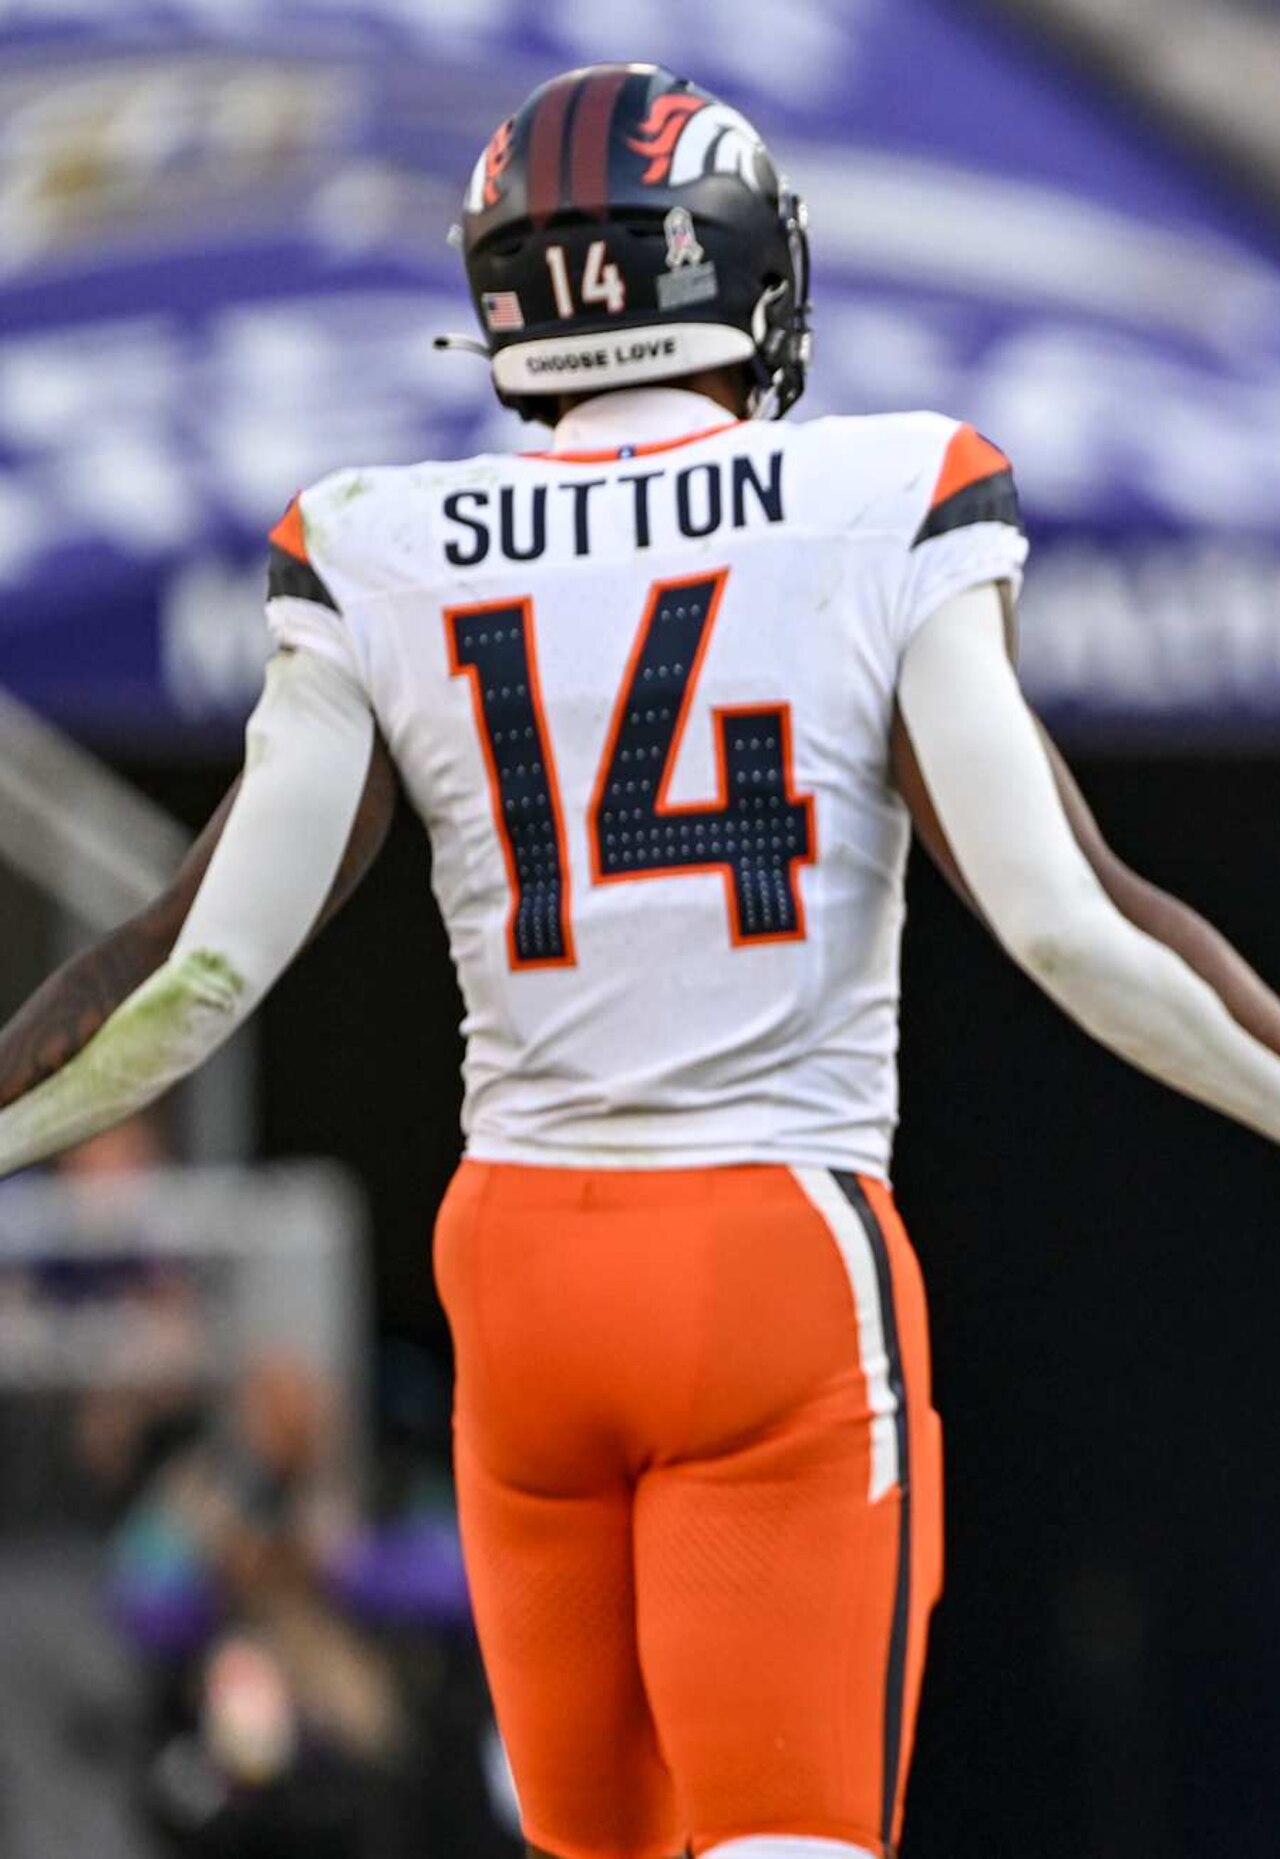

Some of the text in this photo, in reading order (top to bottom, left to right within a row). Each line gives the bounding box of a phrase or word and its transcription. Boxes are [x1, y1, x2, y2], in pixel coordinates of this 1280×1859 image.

[545, 240, 626, 319] 14
[526, 337, 676, 374] CHOOSE LOVE
[442, 450, 785, 566] SUTTON
[442, 565, 818, 972] 14
